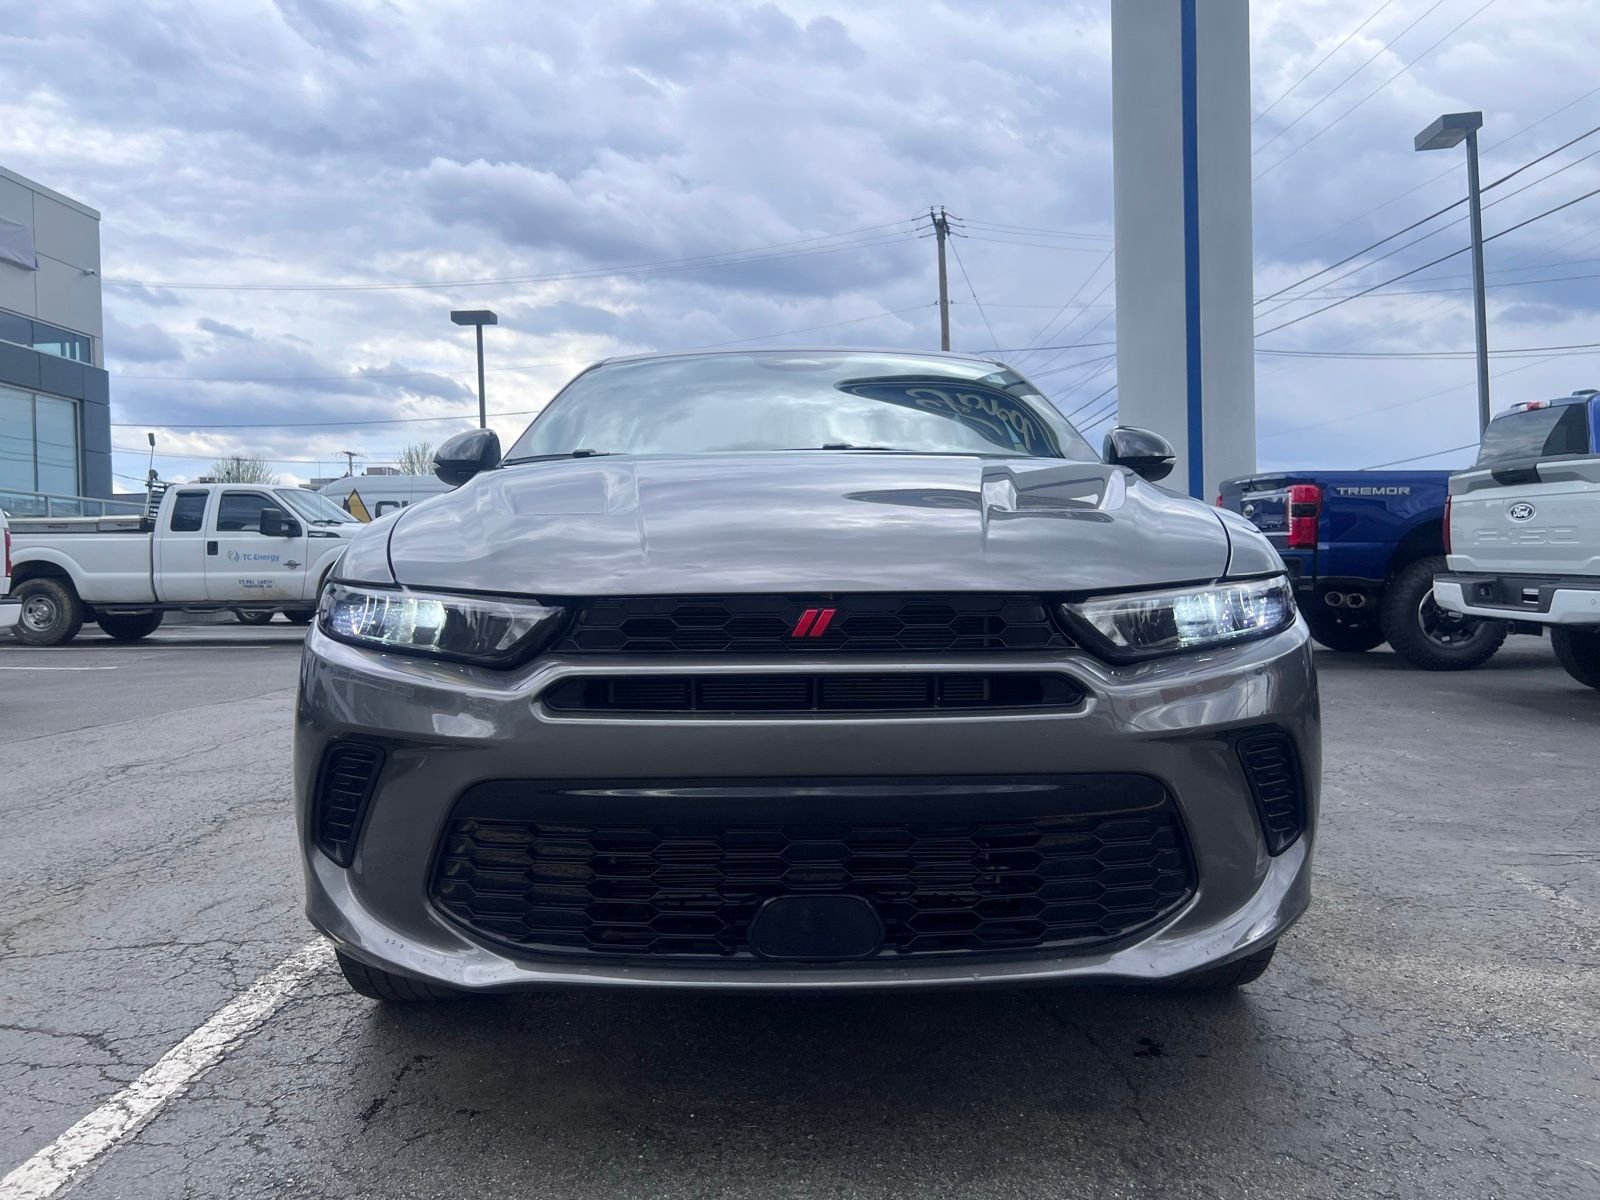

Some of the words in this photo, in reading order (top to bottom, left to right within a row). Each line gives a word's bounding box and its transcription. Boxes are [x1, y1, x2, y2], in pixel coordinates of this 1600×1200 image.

[1336, 486, 1410, 496] TREMOR
[1512, 504, 1532, 518] Ford
[242, 553, 252, 561] TC
[253, 553, 280, 562] Energy
